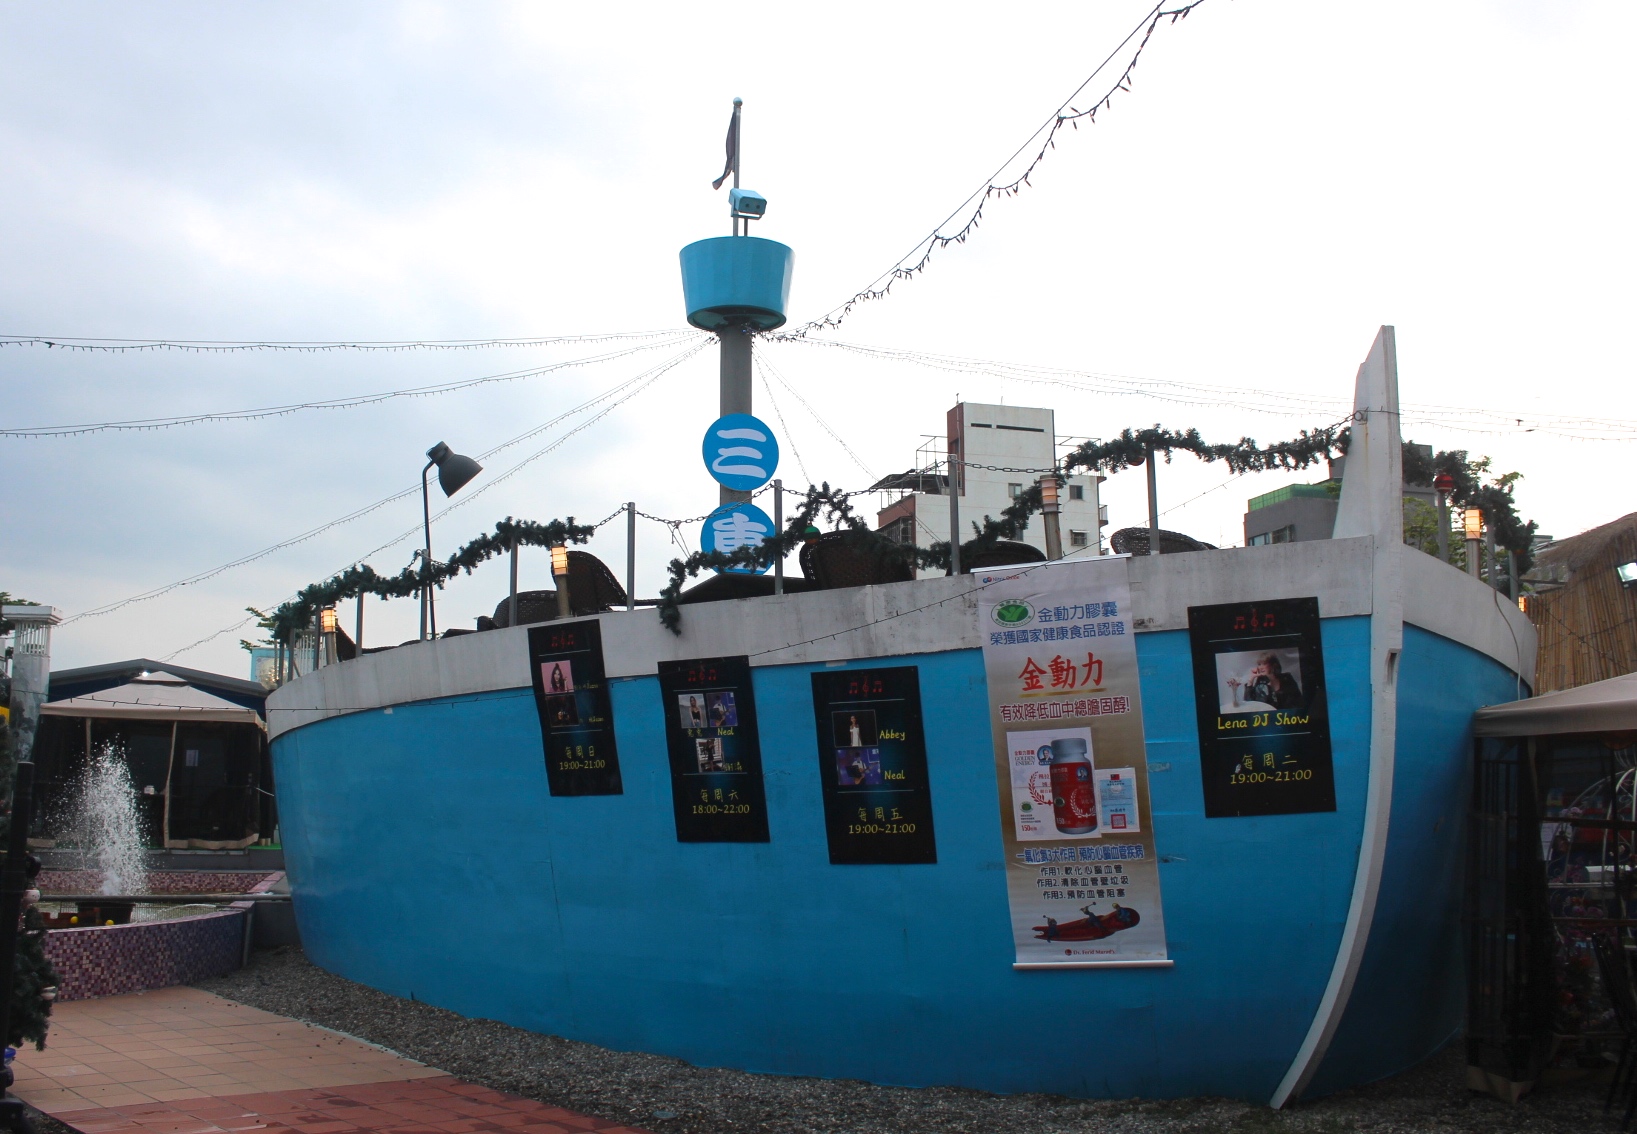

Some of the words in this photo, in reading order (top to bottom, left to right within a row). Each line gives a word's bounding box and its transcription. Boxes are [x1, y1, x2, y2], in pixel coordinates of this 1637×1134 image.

[1037, 601, 1118, 623] 金動力膠囊
[990, 621, 1126, 646] 榮獲國家健康食品認證
[1018, 651, 1104, 692] 金動力
[999, 696, 1130, 722] 有效降低血中總膽固醇!
[1217, 716, 1248, 730] Lena
[1252, 713, 1269, 727] DJ
[1275, 712, 1310, 726] Show
[879, 729, 906, 741] Abbey
[559, 759, 606, 770] 19:00~21:00
[884, 770, 906, 780] Neal
[1230, 769, 1313, 785] 19:00~21:00
[692, 804, 750, 814] 18:00~22:00
[848, 823, 916, 834] 19:00~21:00
